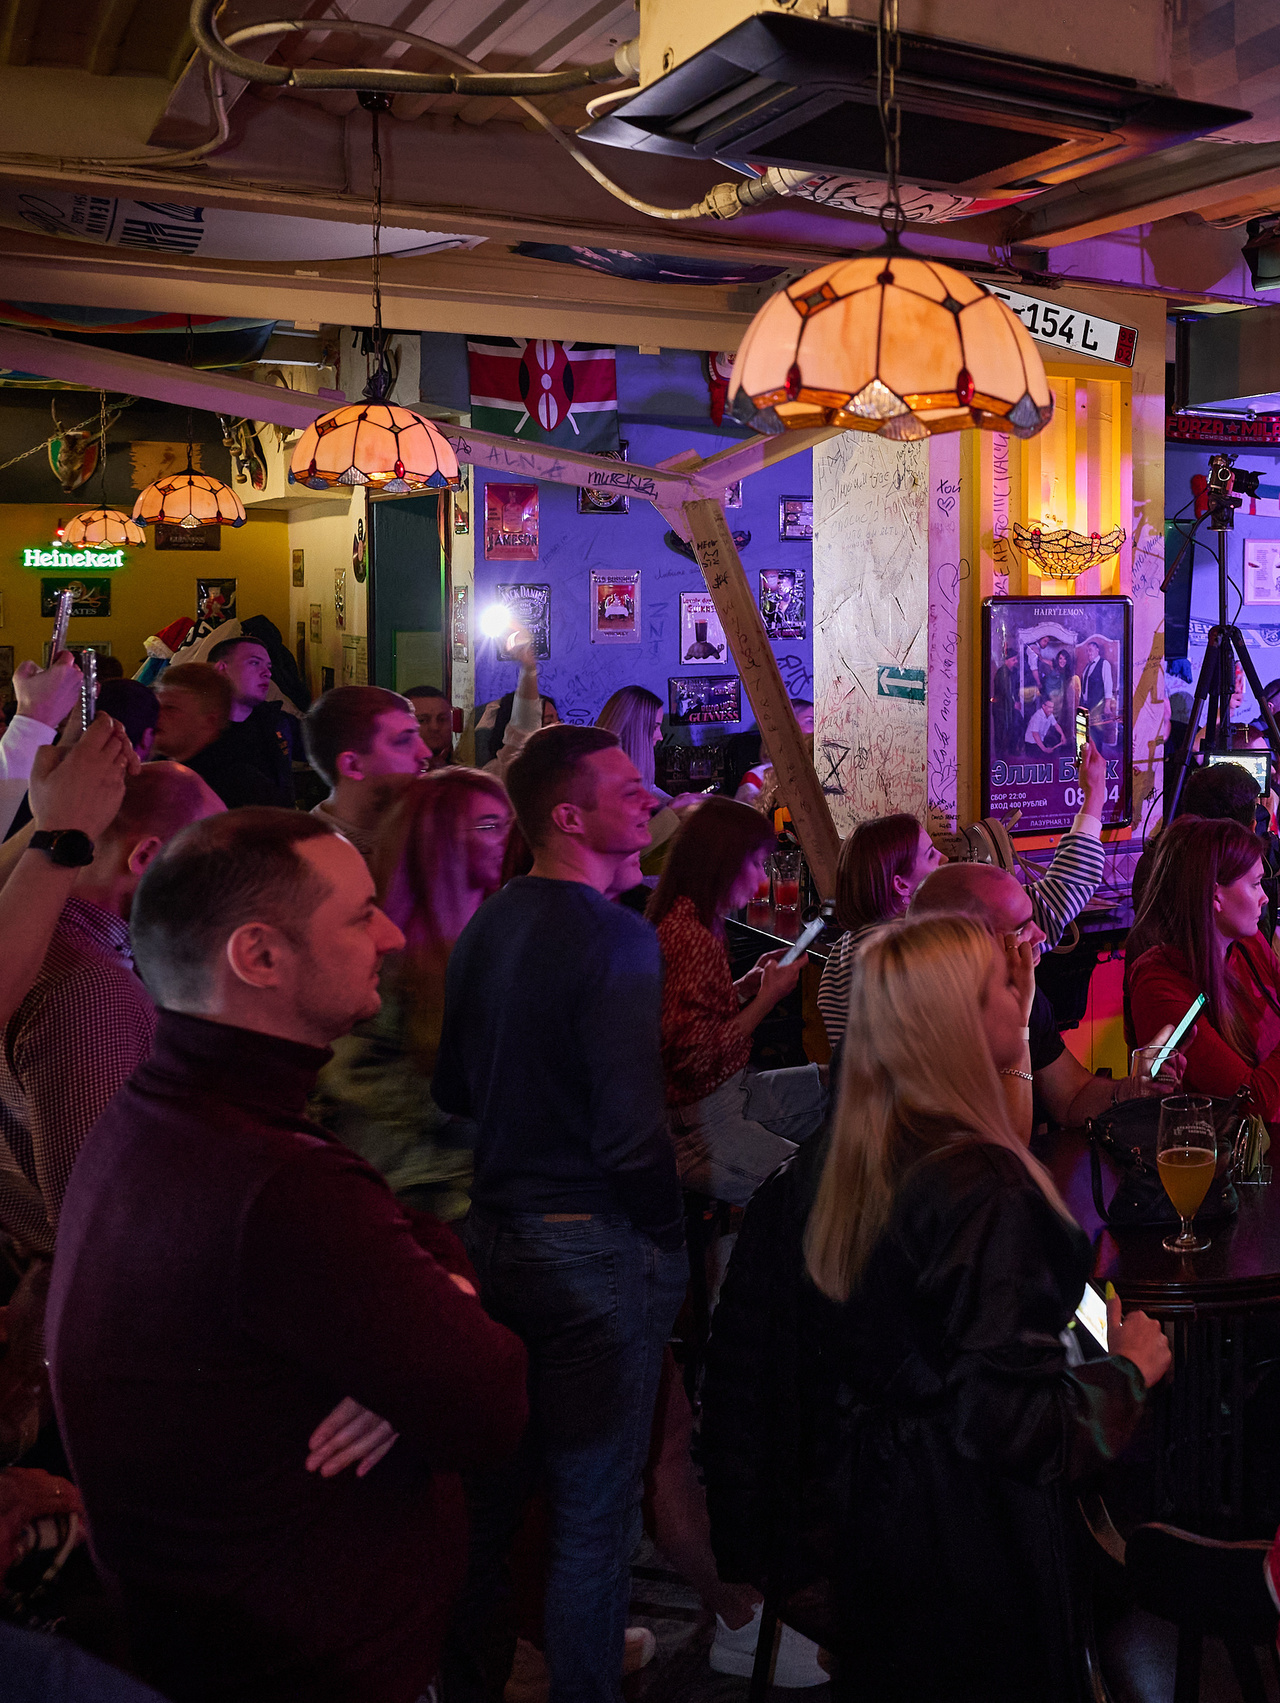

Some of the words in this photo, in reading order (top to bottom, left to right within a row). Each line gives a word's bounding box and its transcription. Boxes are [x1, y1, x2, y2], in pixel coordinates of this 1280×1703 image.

[1166, 417, 1224, 434] FORZA
[23, 549, 125, 568] Heineken
[1033, 608, 1058, 616] HAIRY
[1058, 608, 1084, 616] LEMON
[688, 711, 739, 723] GUINNESS
[991, 760, 1054, 787] Элли
[1058, 757, 1119, 783] Бк
[990, 793, 1007, 801] СБОР
[1008, 792, 1027, 800] 22:00
[1064, 785, 1120, 807] 084
[990, 802, 1009, 810] ВХОД
[1022, 798, 1048, 808] РУБЛЕЙ
